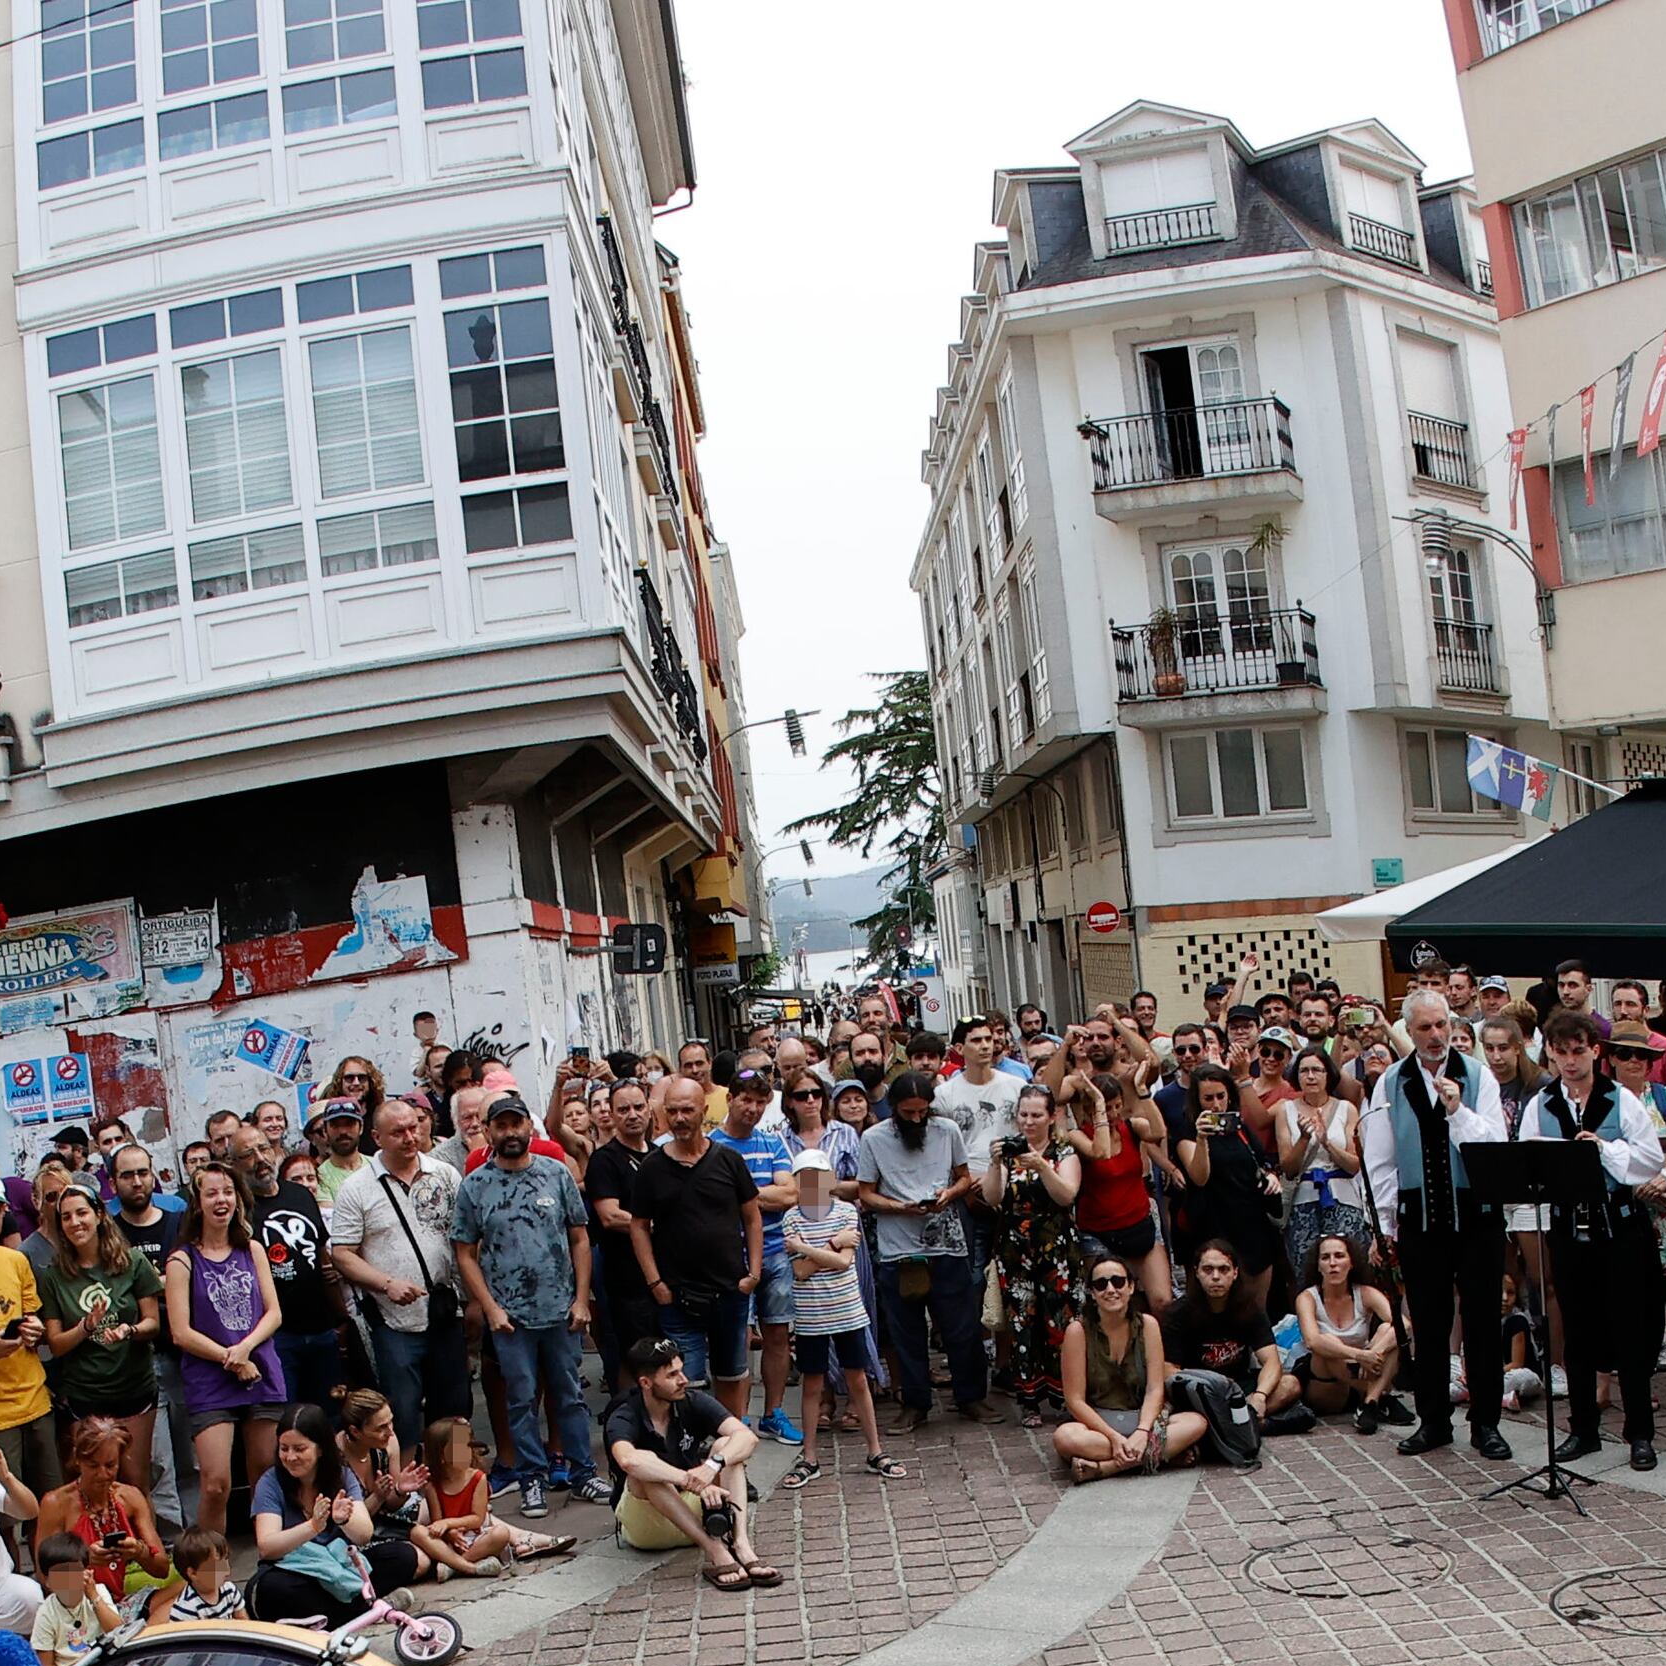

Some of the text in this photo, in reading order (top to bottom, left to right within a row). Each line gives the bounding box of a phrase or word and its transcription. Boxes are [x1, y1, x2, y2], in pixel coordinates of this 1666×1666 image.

[142, 917, 209, 931] ORTIGUEIRA
[50, 938, 67, 949] de
[154, 940, 169, 955] 12
[194, 936, 209, 951] 14
[696, 967, 734, 980] FOTO PLATAS
[11, 1087, 41, 1098] ALDEAS
[54, 1081, 86, 1092] ALDEAS
